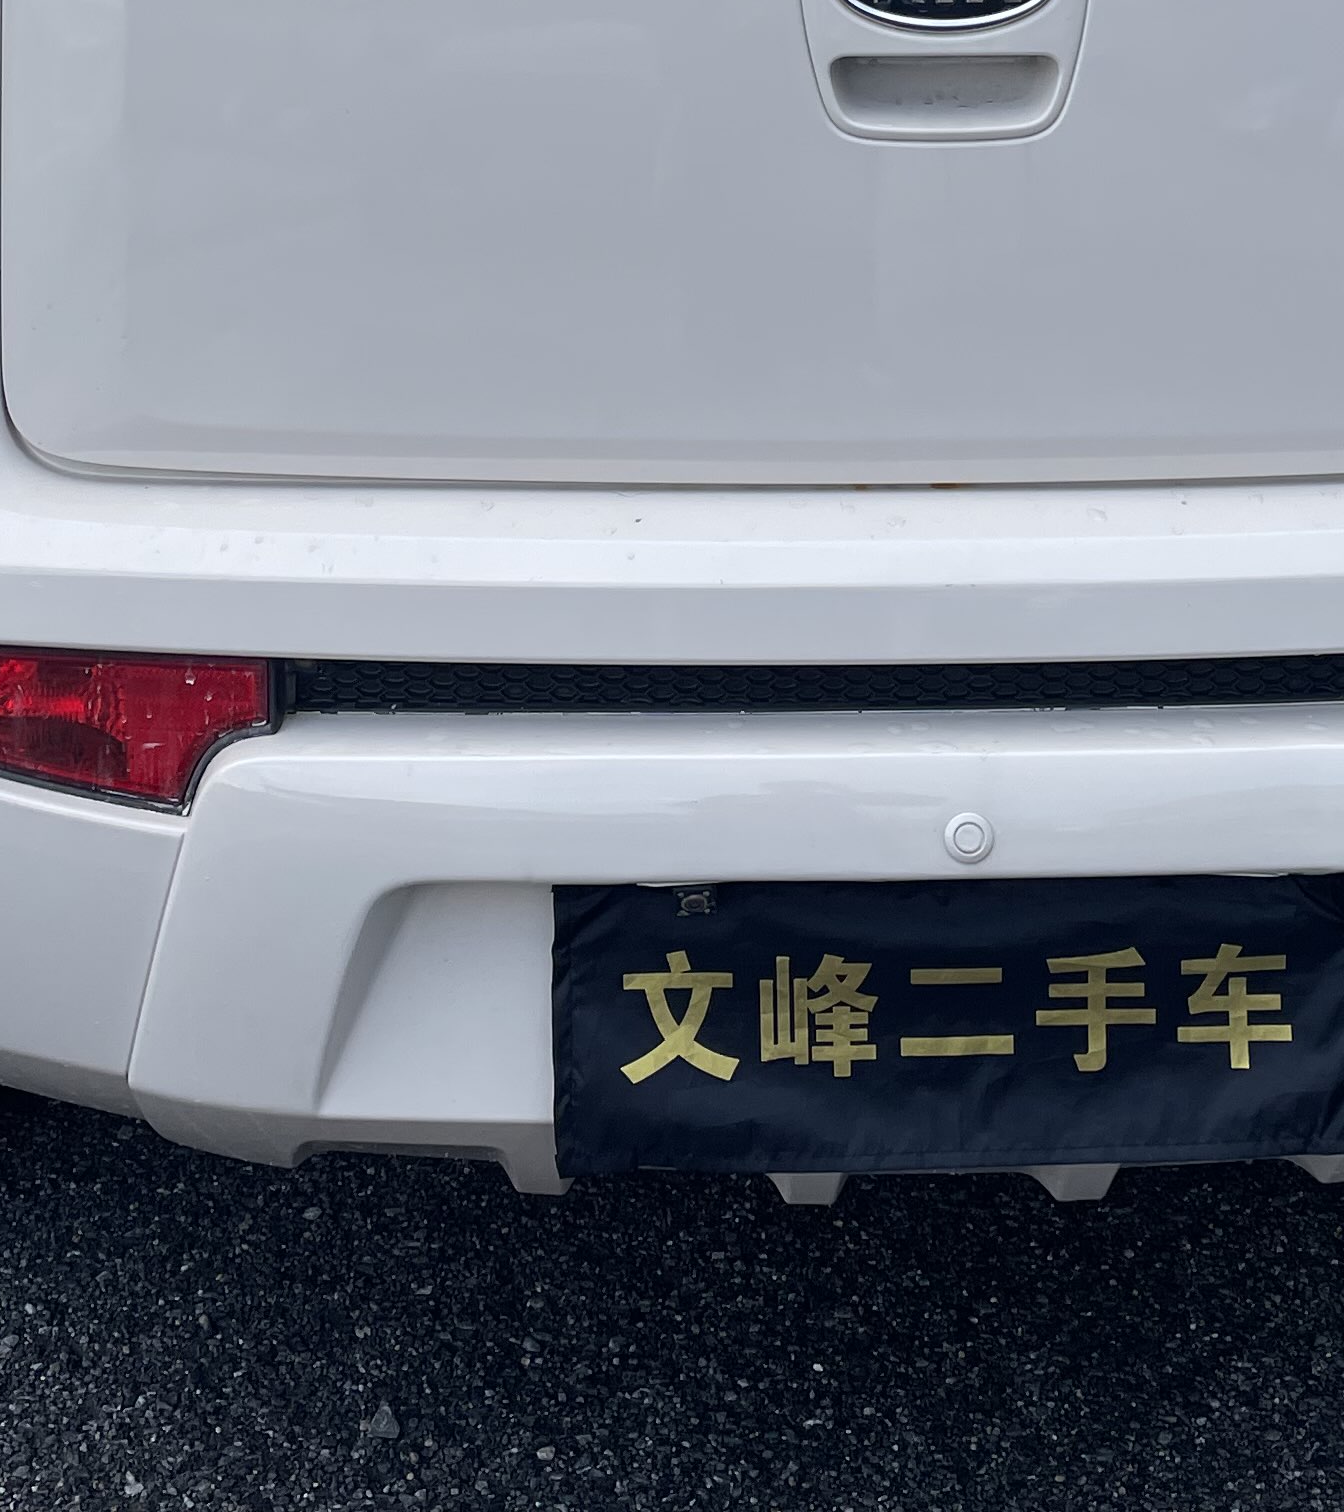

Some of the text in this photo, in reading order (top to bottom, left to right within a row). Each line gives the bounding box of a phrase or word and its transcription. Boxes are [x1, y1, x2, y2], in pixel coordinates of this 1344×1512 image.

[618, 942, 1294, 1085] 文峰二手车
